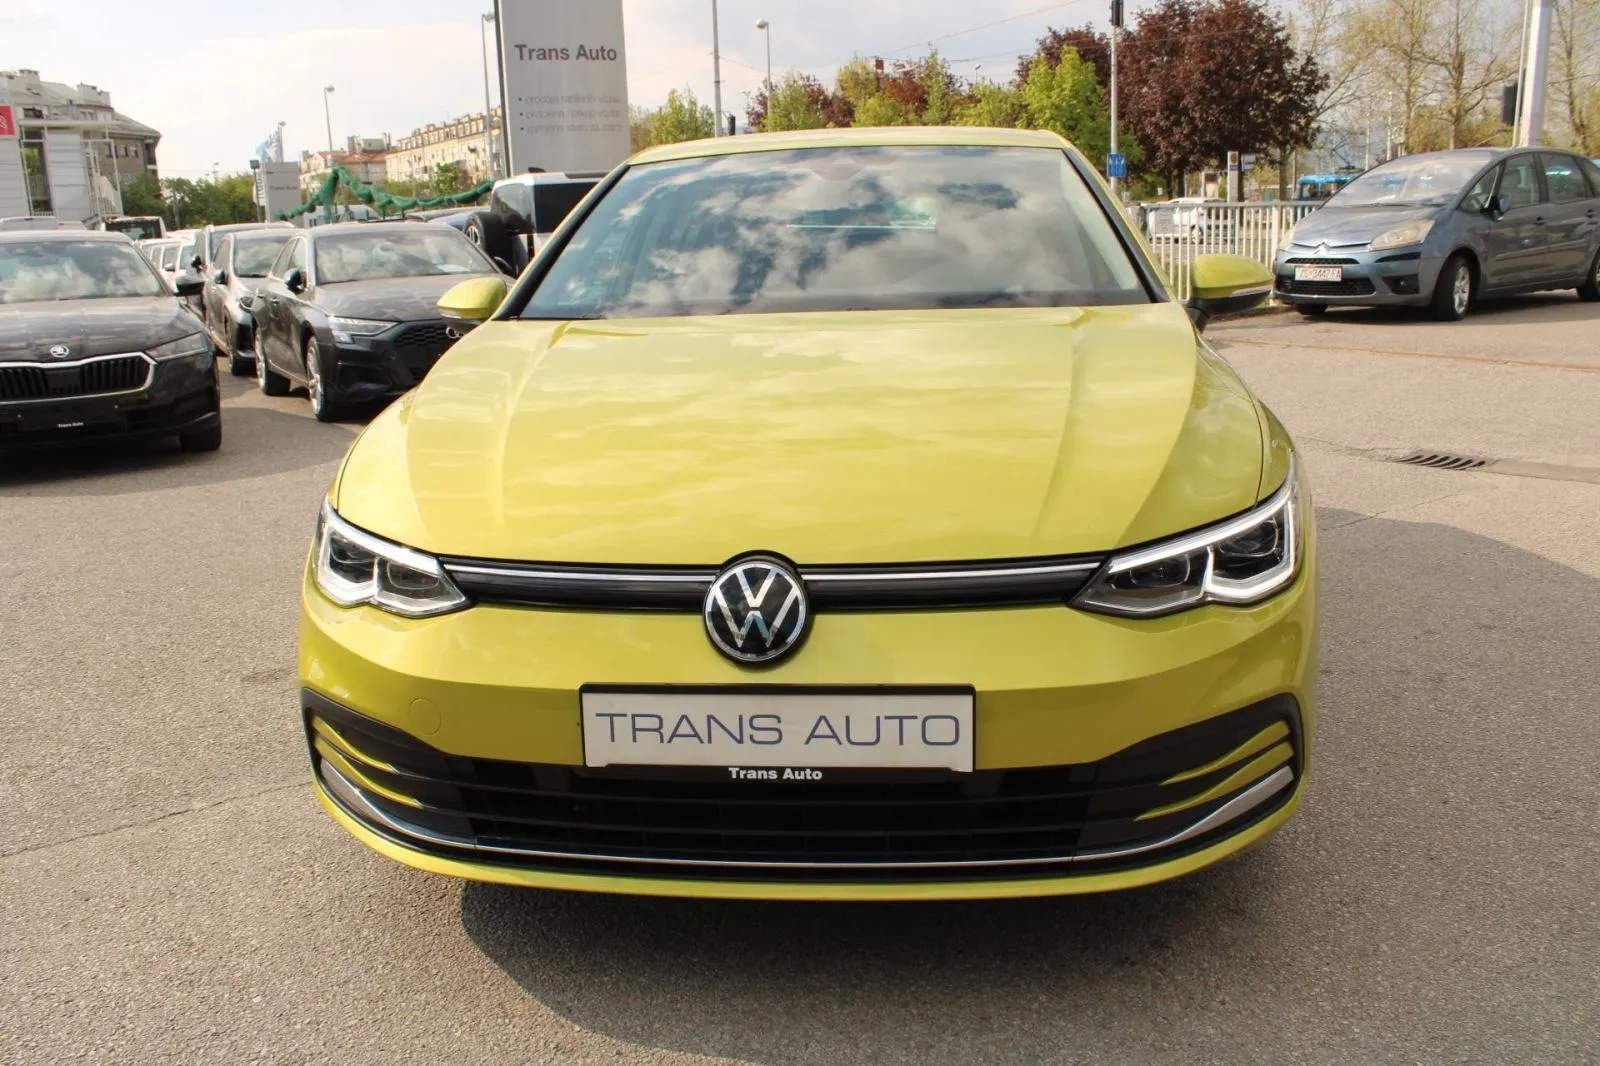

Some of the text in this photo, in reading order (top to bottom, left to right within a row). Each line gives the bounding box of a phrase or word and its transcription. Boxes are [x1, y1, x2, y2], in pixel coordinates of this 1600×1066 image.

[514, 44, 617, 61] Trans Auto
[595, 713, 961, 747] TRANS AUTO
[728, 767, 823, 781] Trans Auto
